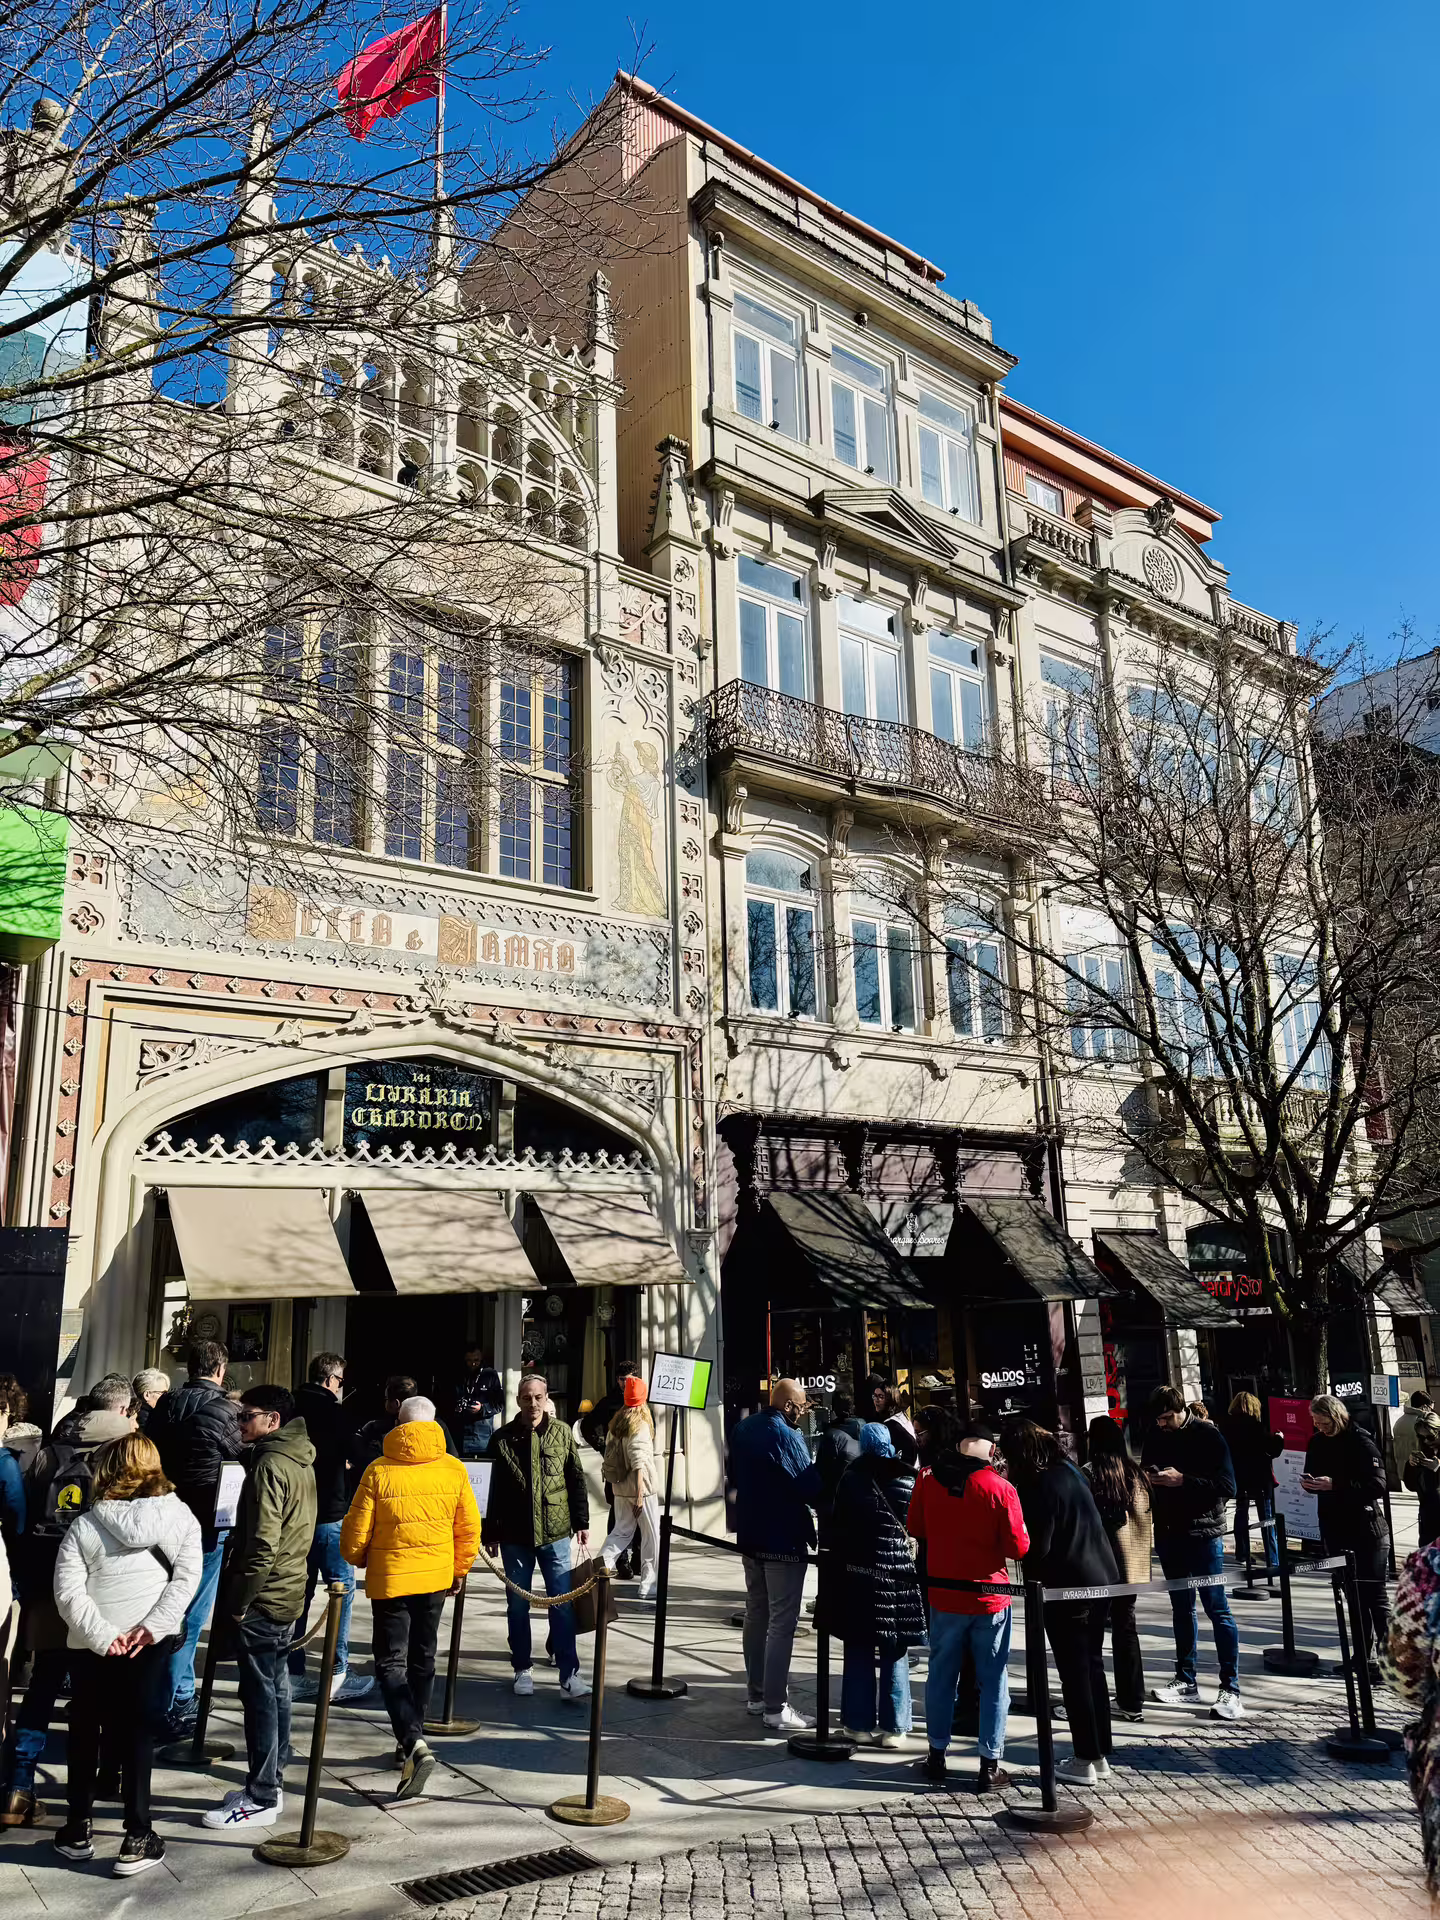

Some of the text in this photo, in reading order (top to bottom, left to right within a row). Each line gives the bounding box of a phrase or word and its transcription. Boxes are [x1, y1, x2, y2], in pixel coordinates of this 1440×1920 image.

[405, 929, 424, 951] &
[412, 1072, 431, 1083] 144
[365, 1083, 473, 1108] LIVRARIA
[351, 1106, 483, 1132] CHARDRON
[795, 1375, 836, 1393] ALDOS
[981, 1370, 1025, 1389] SALDOS
[1335, 1381, 1363, 1397] SALDOS
[981, 1584, 1011, 1594] LIVRARIA
[1062, 1588, 1109, 1600] LIVRARIA LELLO
